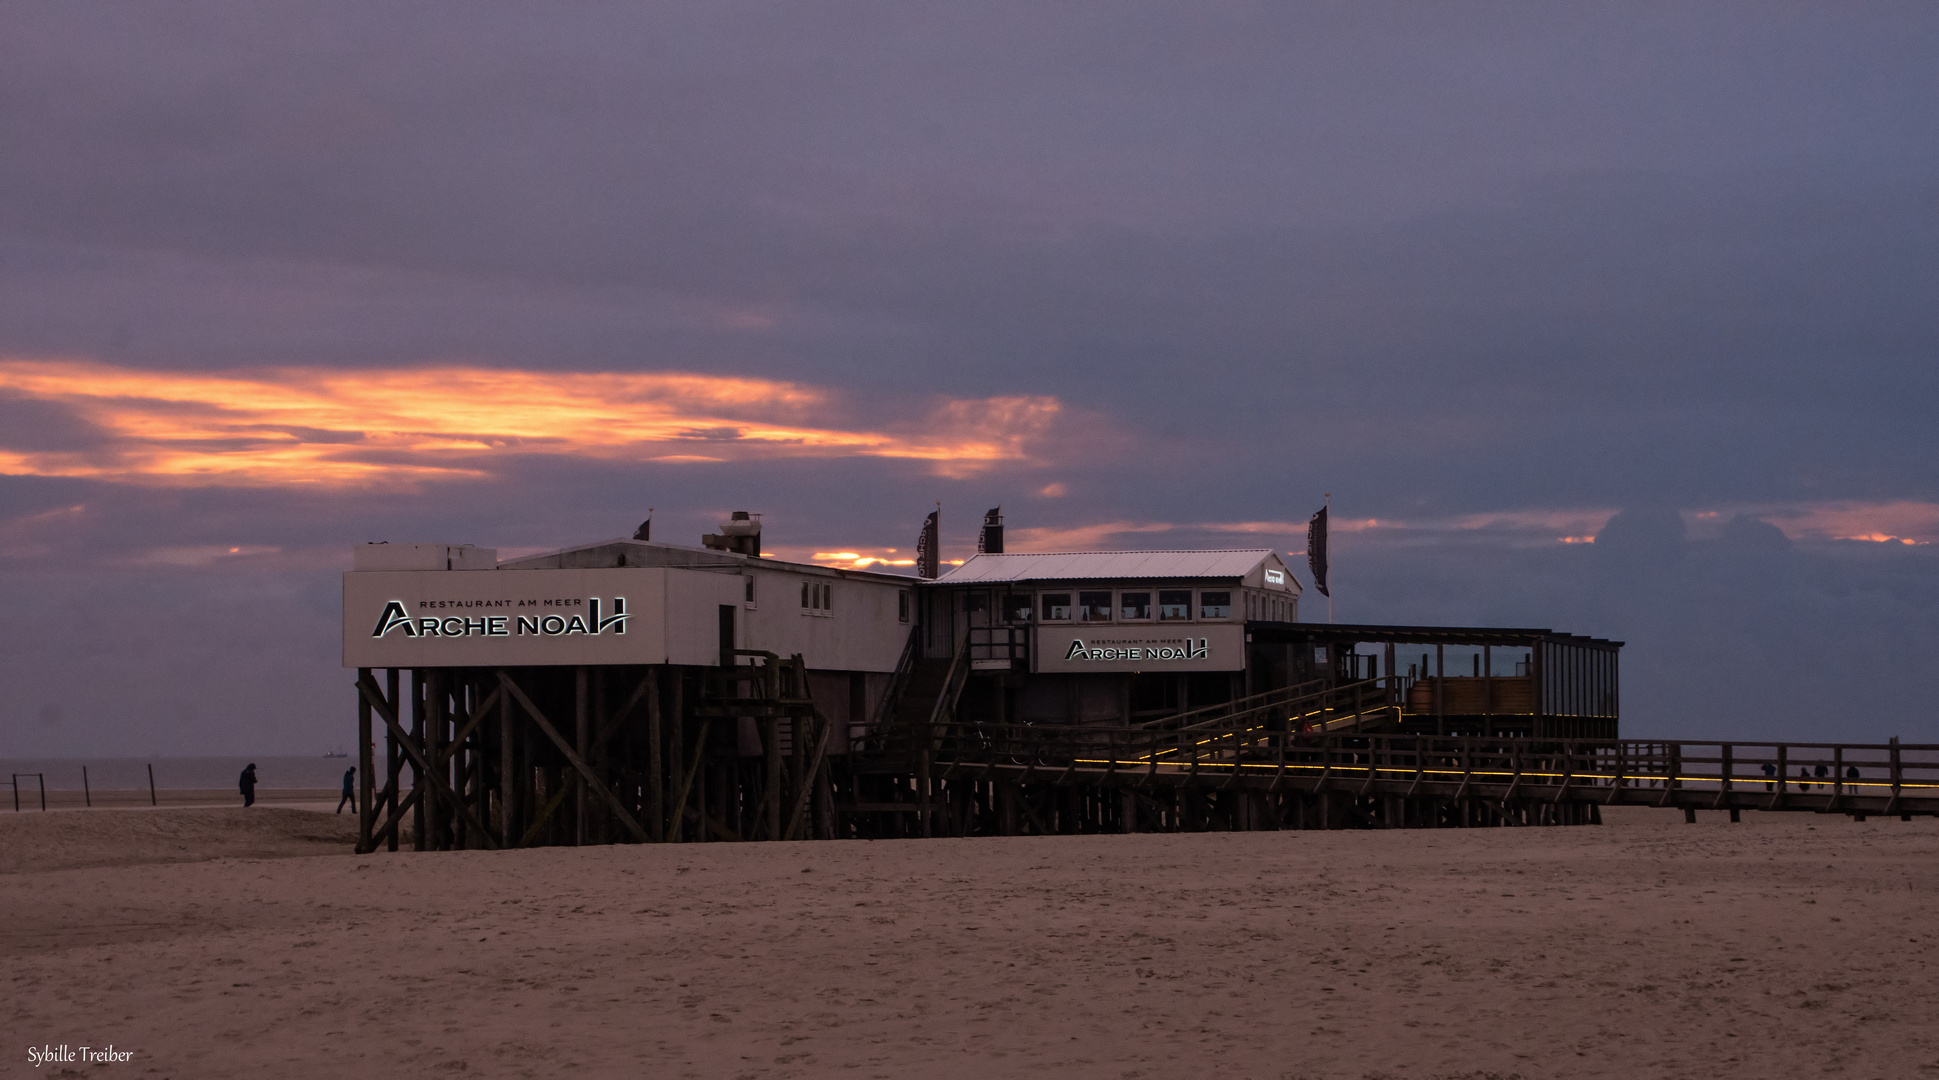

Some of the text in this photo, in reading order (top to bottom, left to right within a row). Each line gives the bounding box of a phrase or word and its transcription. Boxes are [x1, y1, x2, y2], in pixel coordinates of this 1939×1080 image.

[419, 599, 582, 609] RESTAURANT AM MEER
[372, 597, 630, 638] ARCHE NOAH
[1065, 638, 1209, 661] ARCHE NOAH
